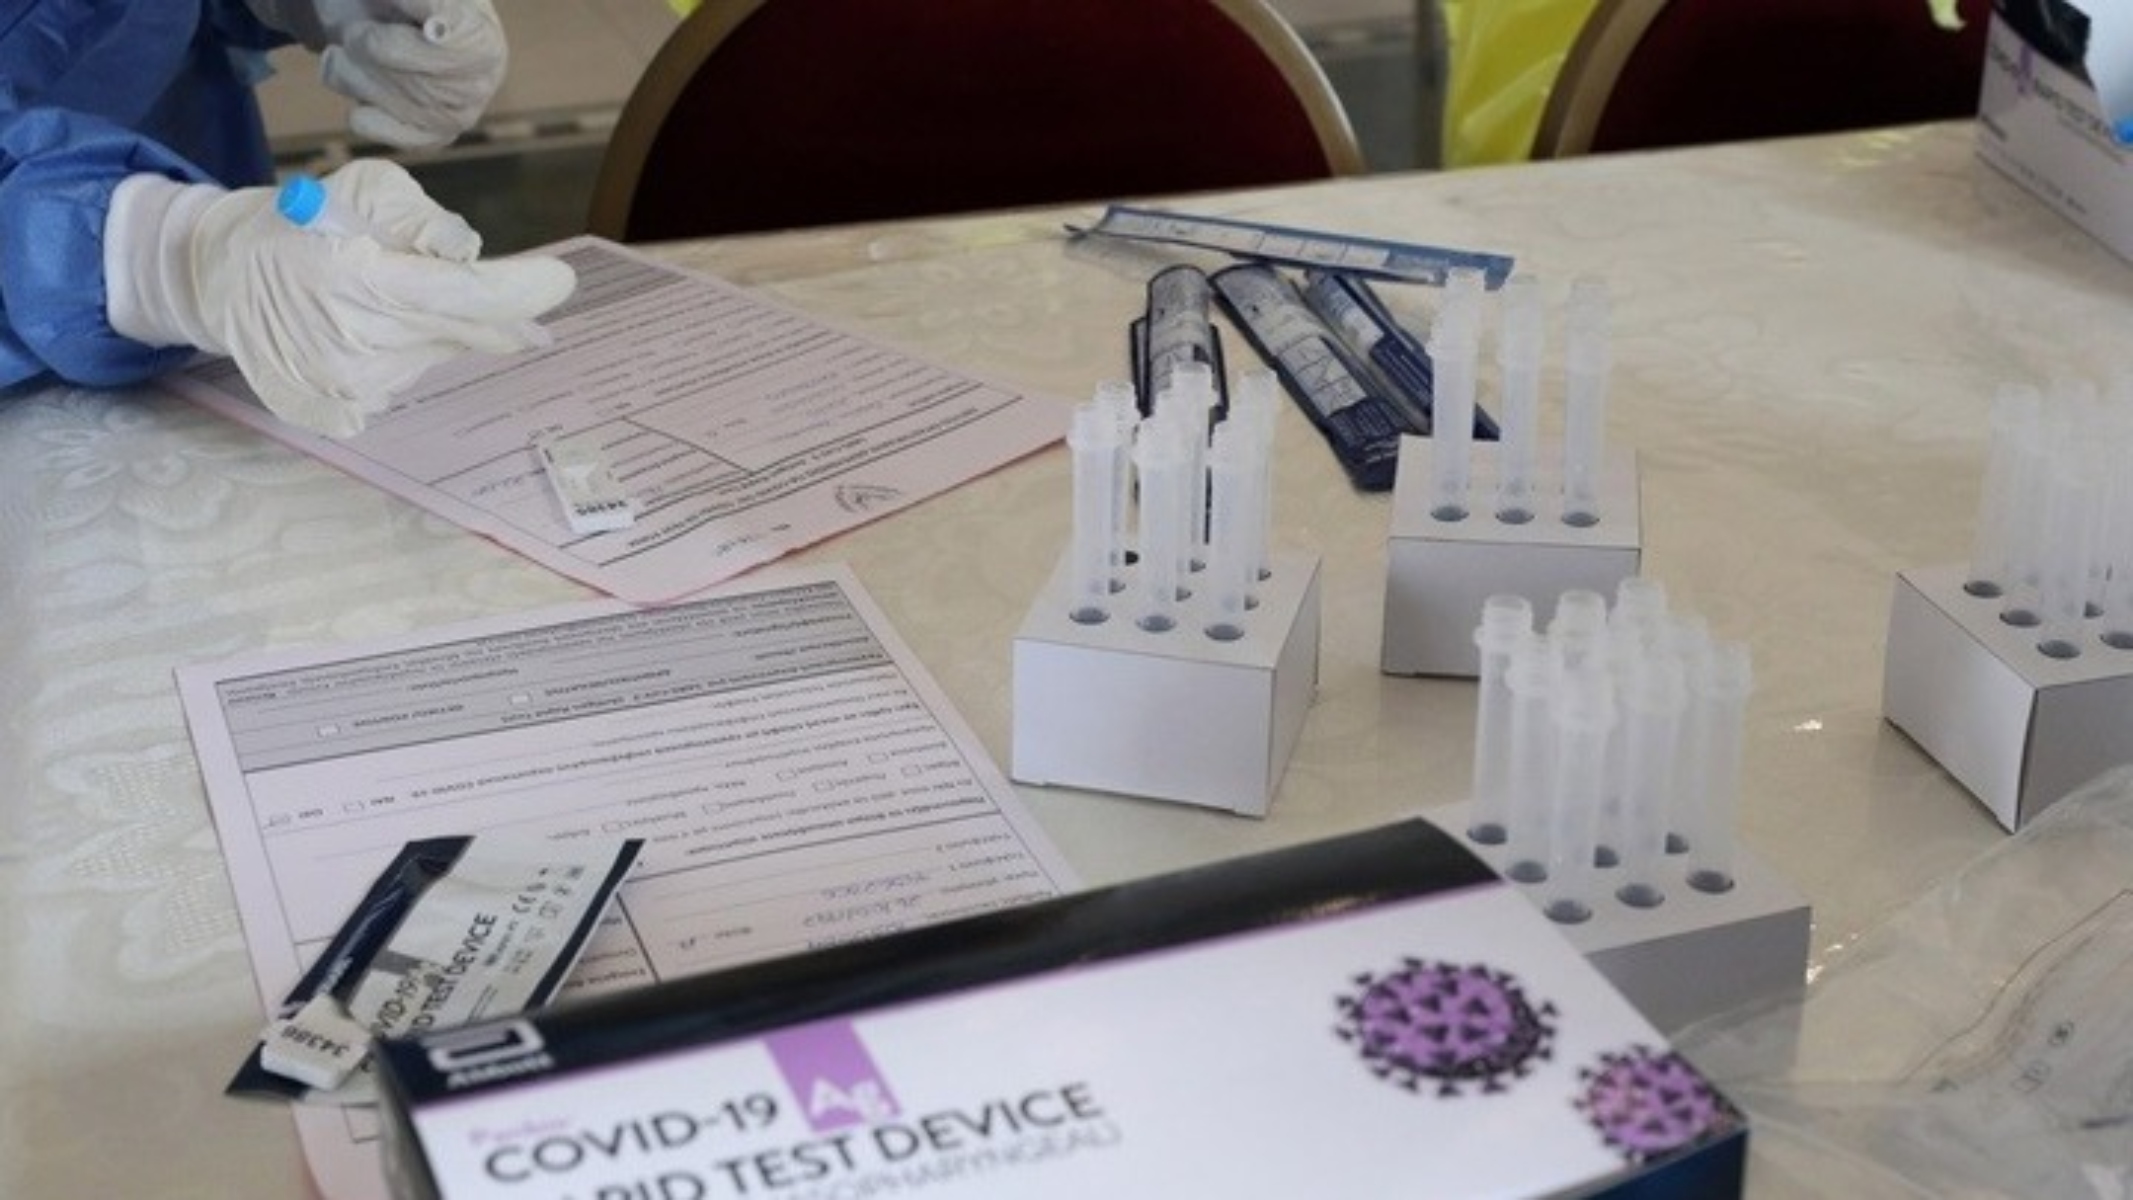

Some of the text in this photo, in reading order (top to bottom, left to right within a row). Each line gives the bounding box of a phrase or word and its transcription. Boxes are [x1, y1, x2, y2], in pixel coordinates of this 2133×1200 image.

[442, 912, 498, 976] DEVICE
[484, 1092, 779, 1183] COVID-19
[714, 1134, 854, 1195] TEST
[871, 1081, 1105, 1162] DEVICE
